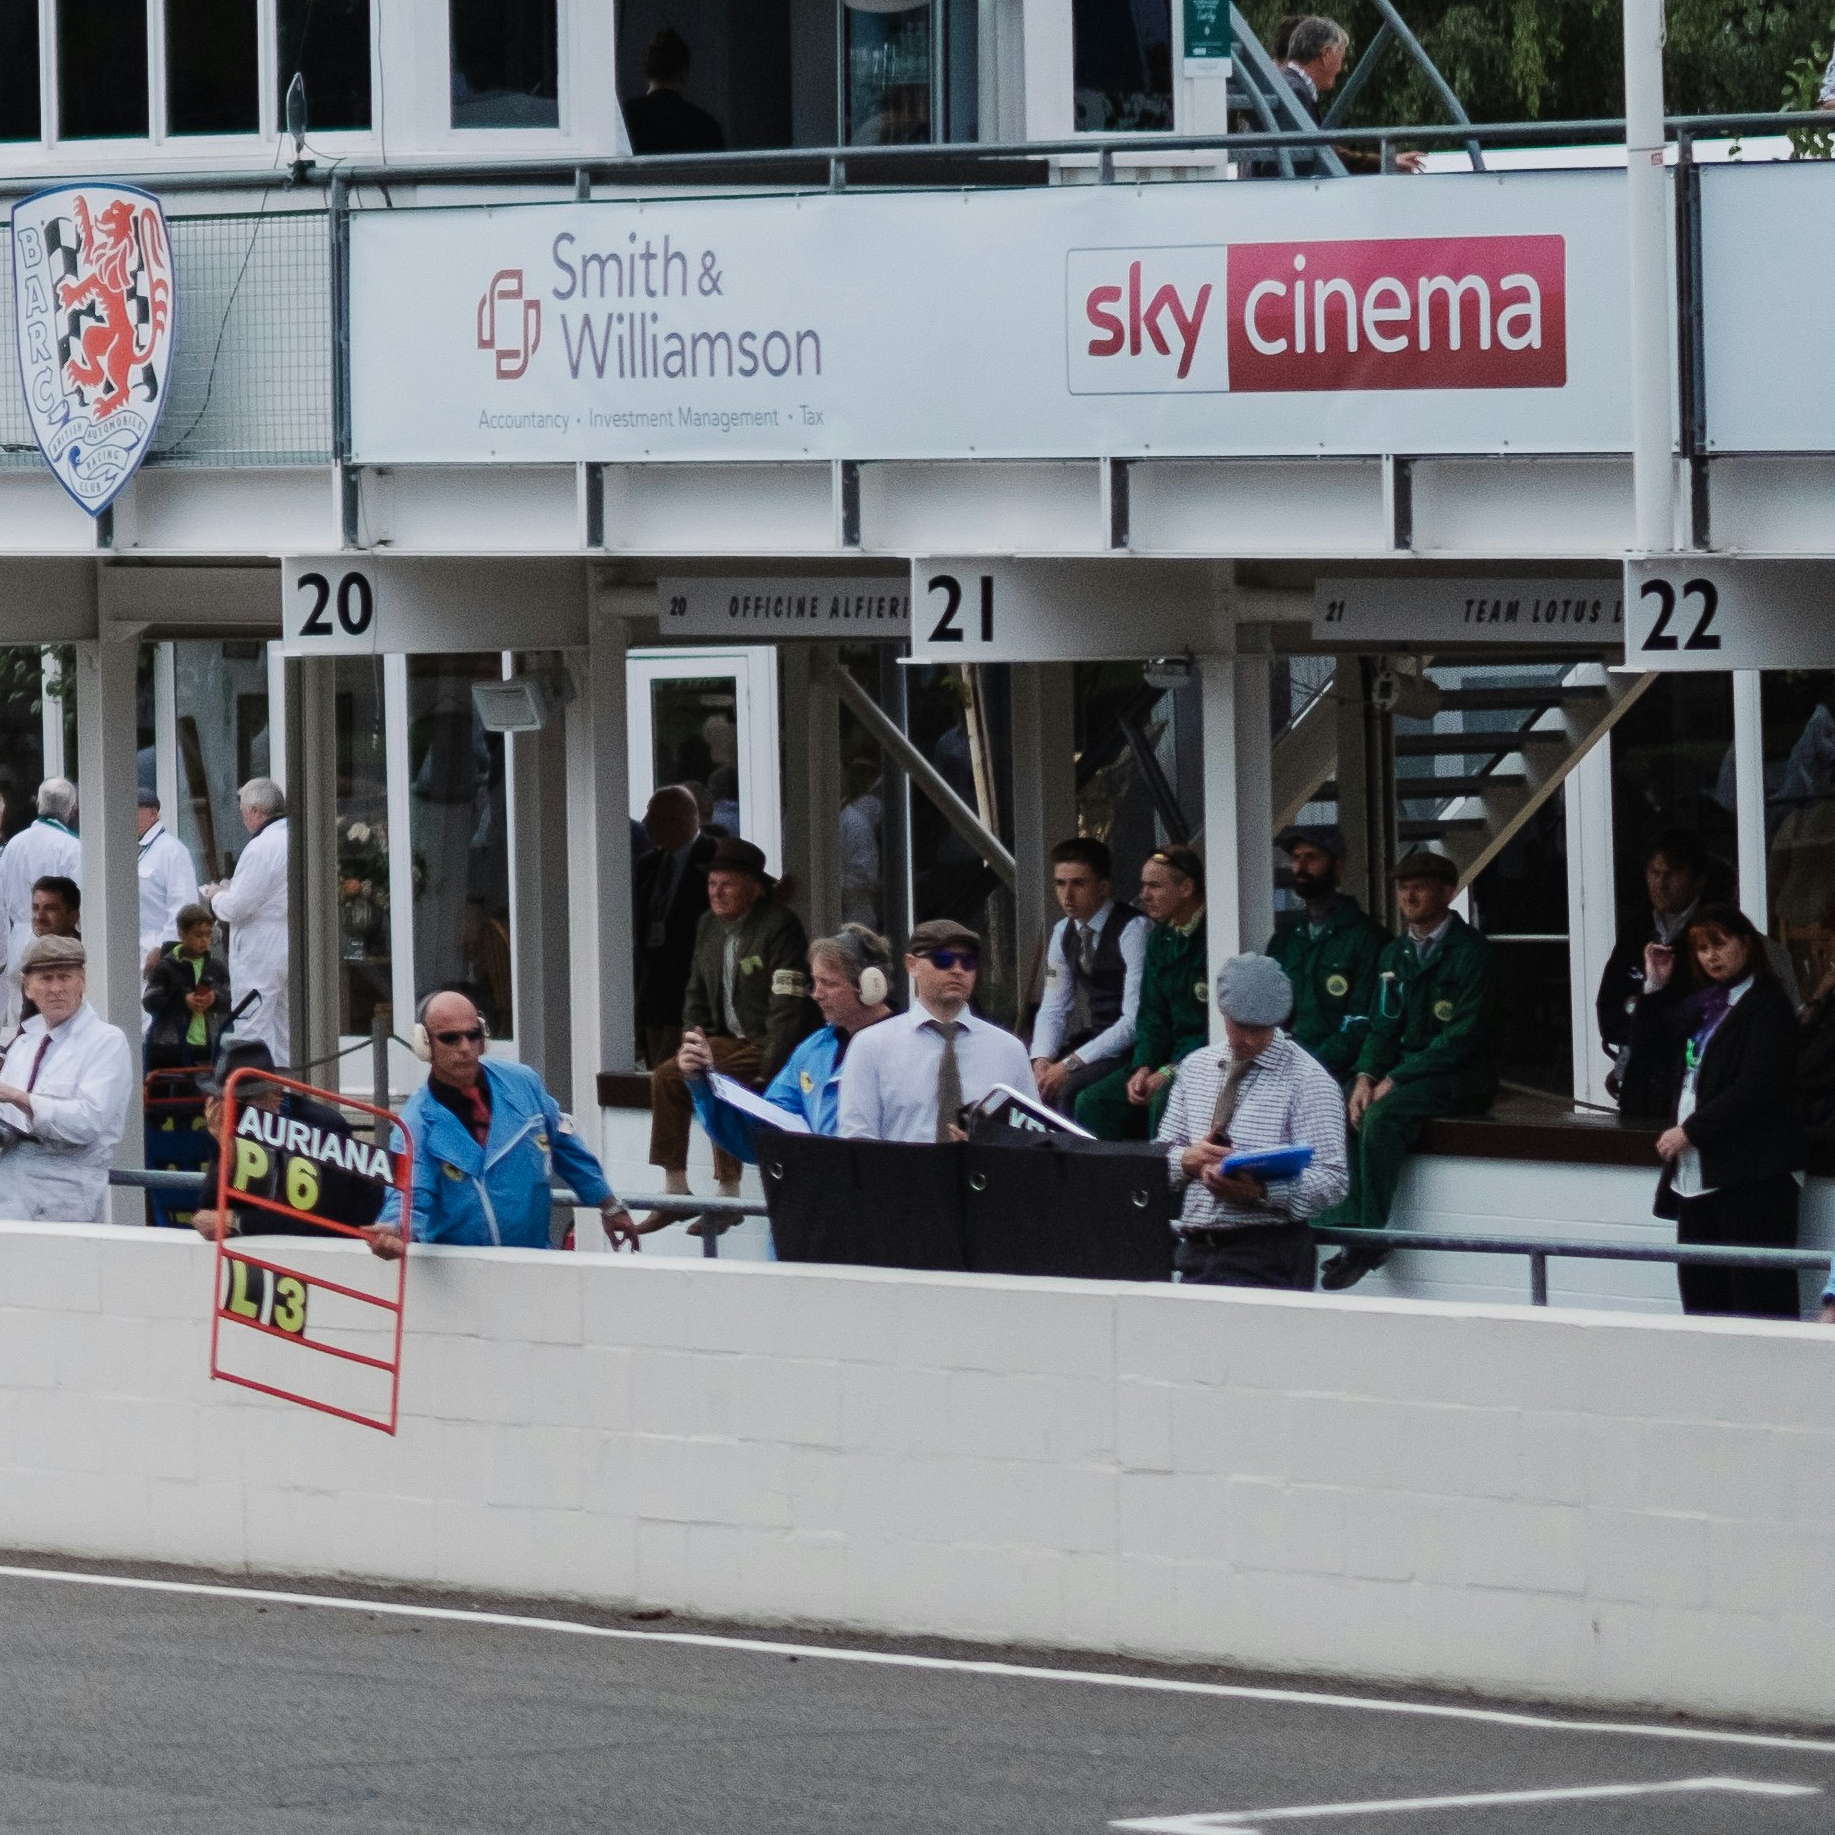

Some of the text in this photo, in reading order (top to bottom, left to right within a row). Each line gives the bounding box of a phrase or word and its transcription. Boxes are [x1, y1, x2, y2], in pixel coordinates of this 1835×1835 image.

[552, 232, 724, 300] Smith &
[18, 226, 58, 414] BARC
[561, 313, 822, 379] Williamson
[1087, 253, 1542, 380] sky cinema
[479, 404, 825, 434] Accountancy Investment Management Tax
[299, 572, 373, 636] 20
[669, 595, 910, 619] 20 OFFICINE ALFIERI
[929, 575, 994, 641] 21
[1325, 600, 1346, 622] 21
[1463, 598, 1521, 624] TEAM
[1532, 598, 1602, 624] LOTUS
[1642, 579, 1721, 650] 22
[232, 1136, 321, 1212] P 6
[236, 1106, 395, 1185] AURIANA
[273, 1276, 307, 1334] 3
